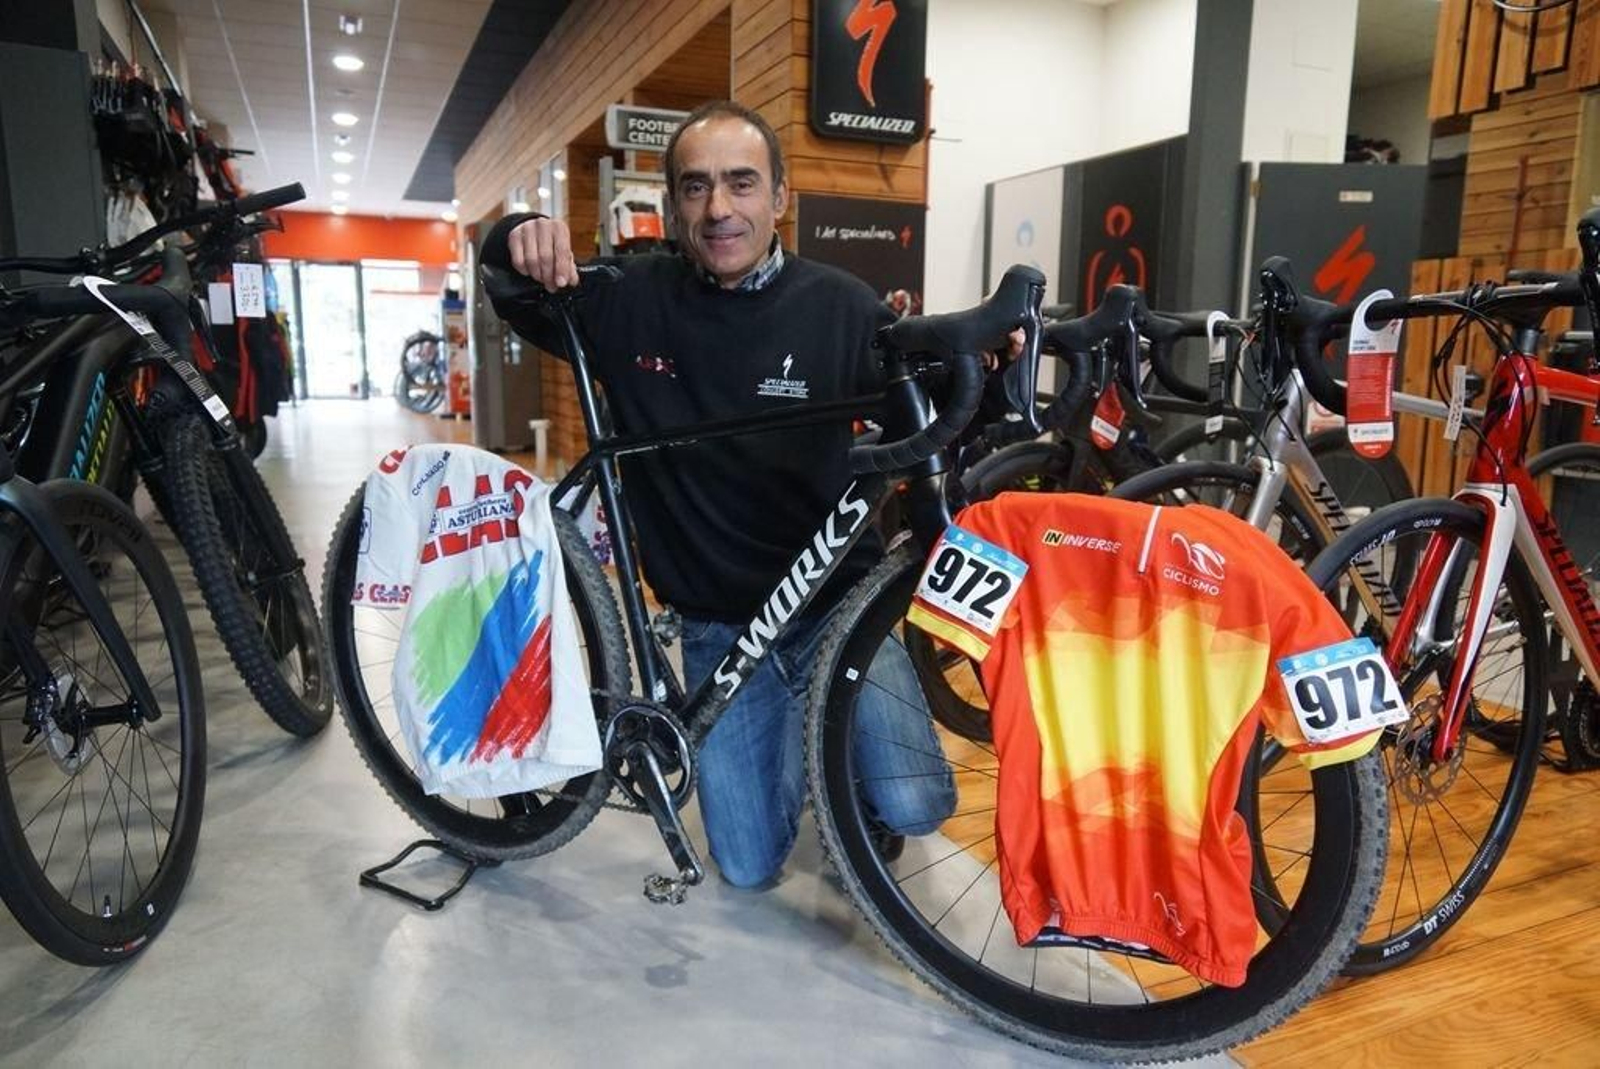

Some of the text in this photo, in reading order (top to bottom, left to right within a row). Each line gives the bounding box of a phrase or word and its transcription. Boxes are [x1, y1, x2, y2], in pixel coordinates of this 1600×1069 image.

[628, 131, 672, 146] CENTE
[825, 111, 916, 134] SPECIALIZED
[1044, 531, 1122, 554] IN INVERSE
[713, 480, 869, 700] S-WORKS
[927, 546, 1012, 620] 972
[1162, 567, 1220, 596] CICLISMO
[1294, 658, 1398, 730] 972
[1423, 890, 1465, 936] DT SWISS
